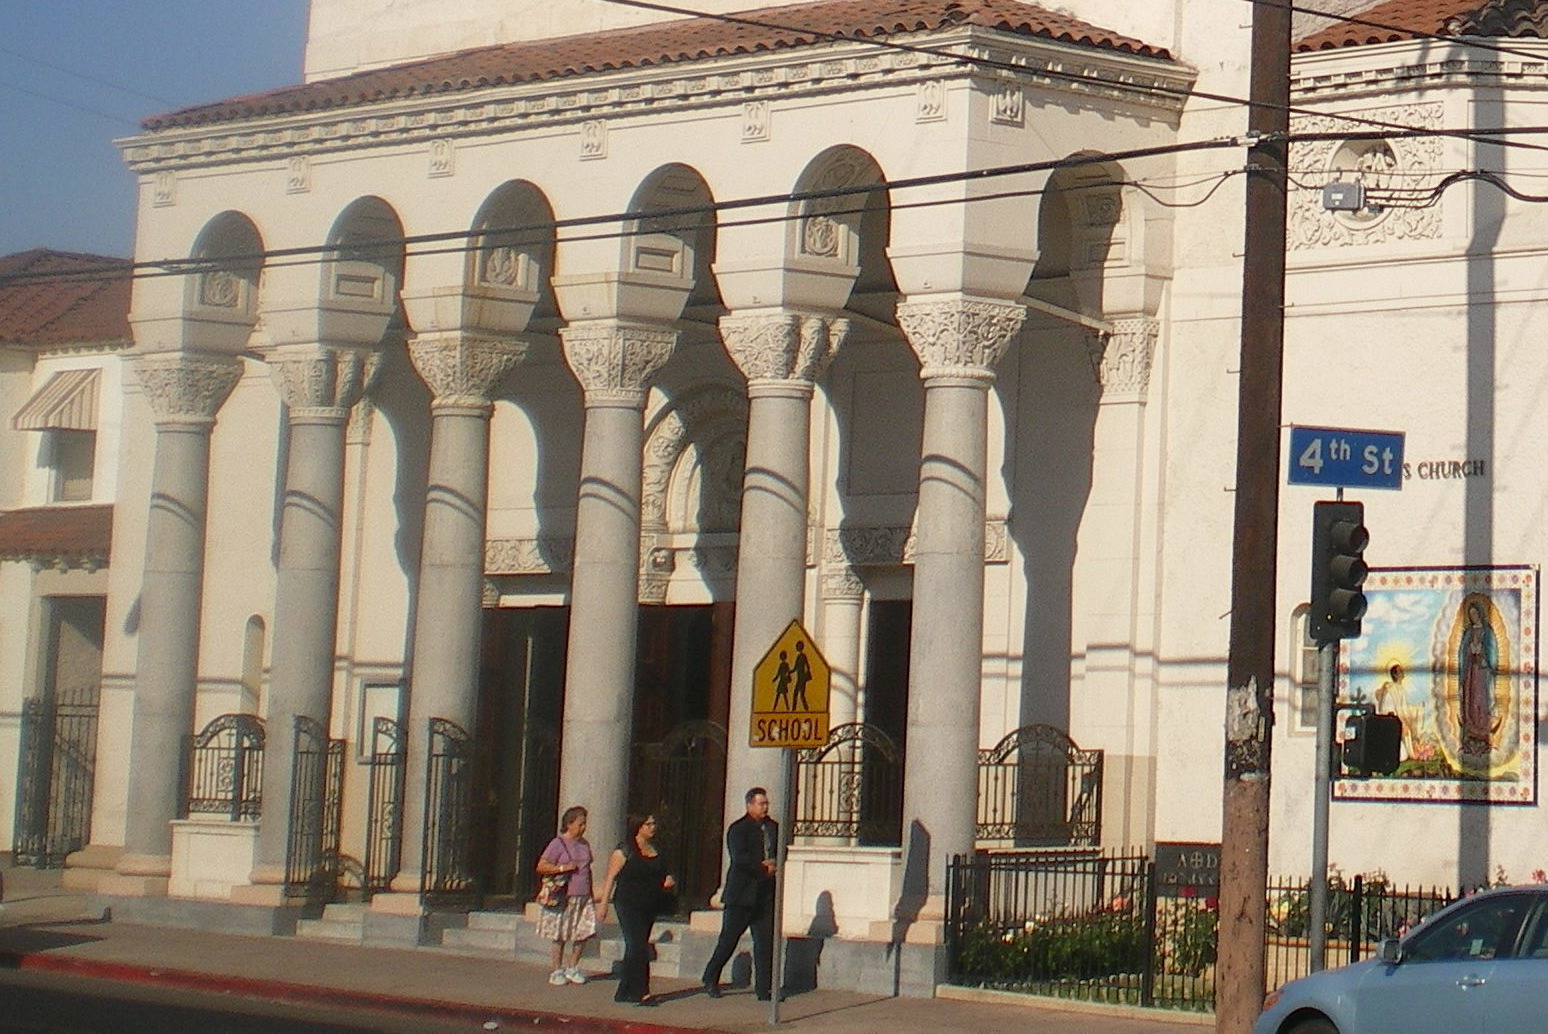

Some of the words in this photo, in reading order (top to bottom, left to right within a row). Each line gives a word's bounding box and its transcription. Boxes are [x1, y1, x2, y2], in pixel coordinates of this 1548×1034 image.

[1299, 438, 1350, 474] 4th
[1362, 445, 1393, 475] St
[1417, 459, 1485, 480] CHURCH
[757, 718, 822, 742] SCHOOL
